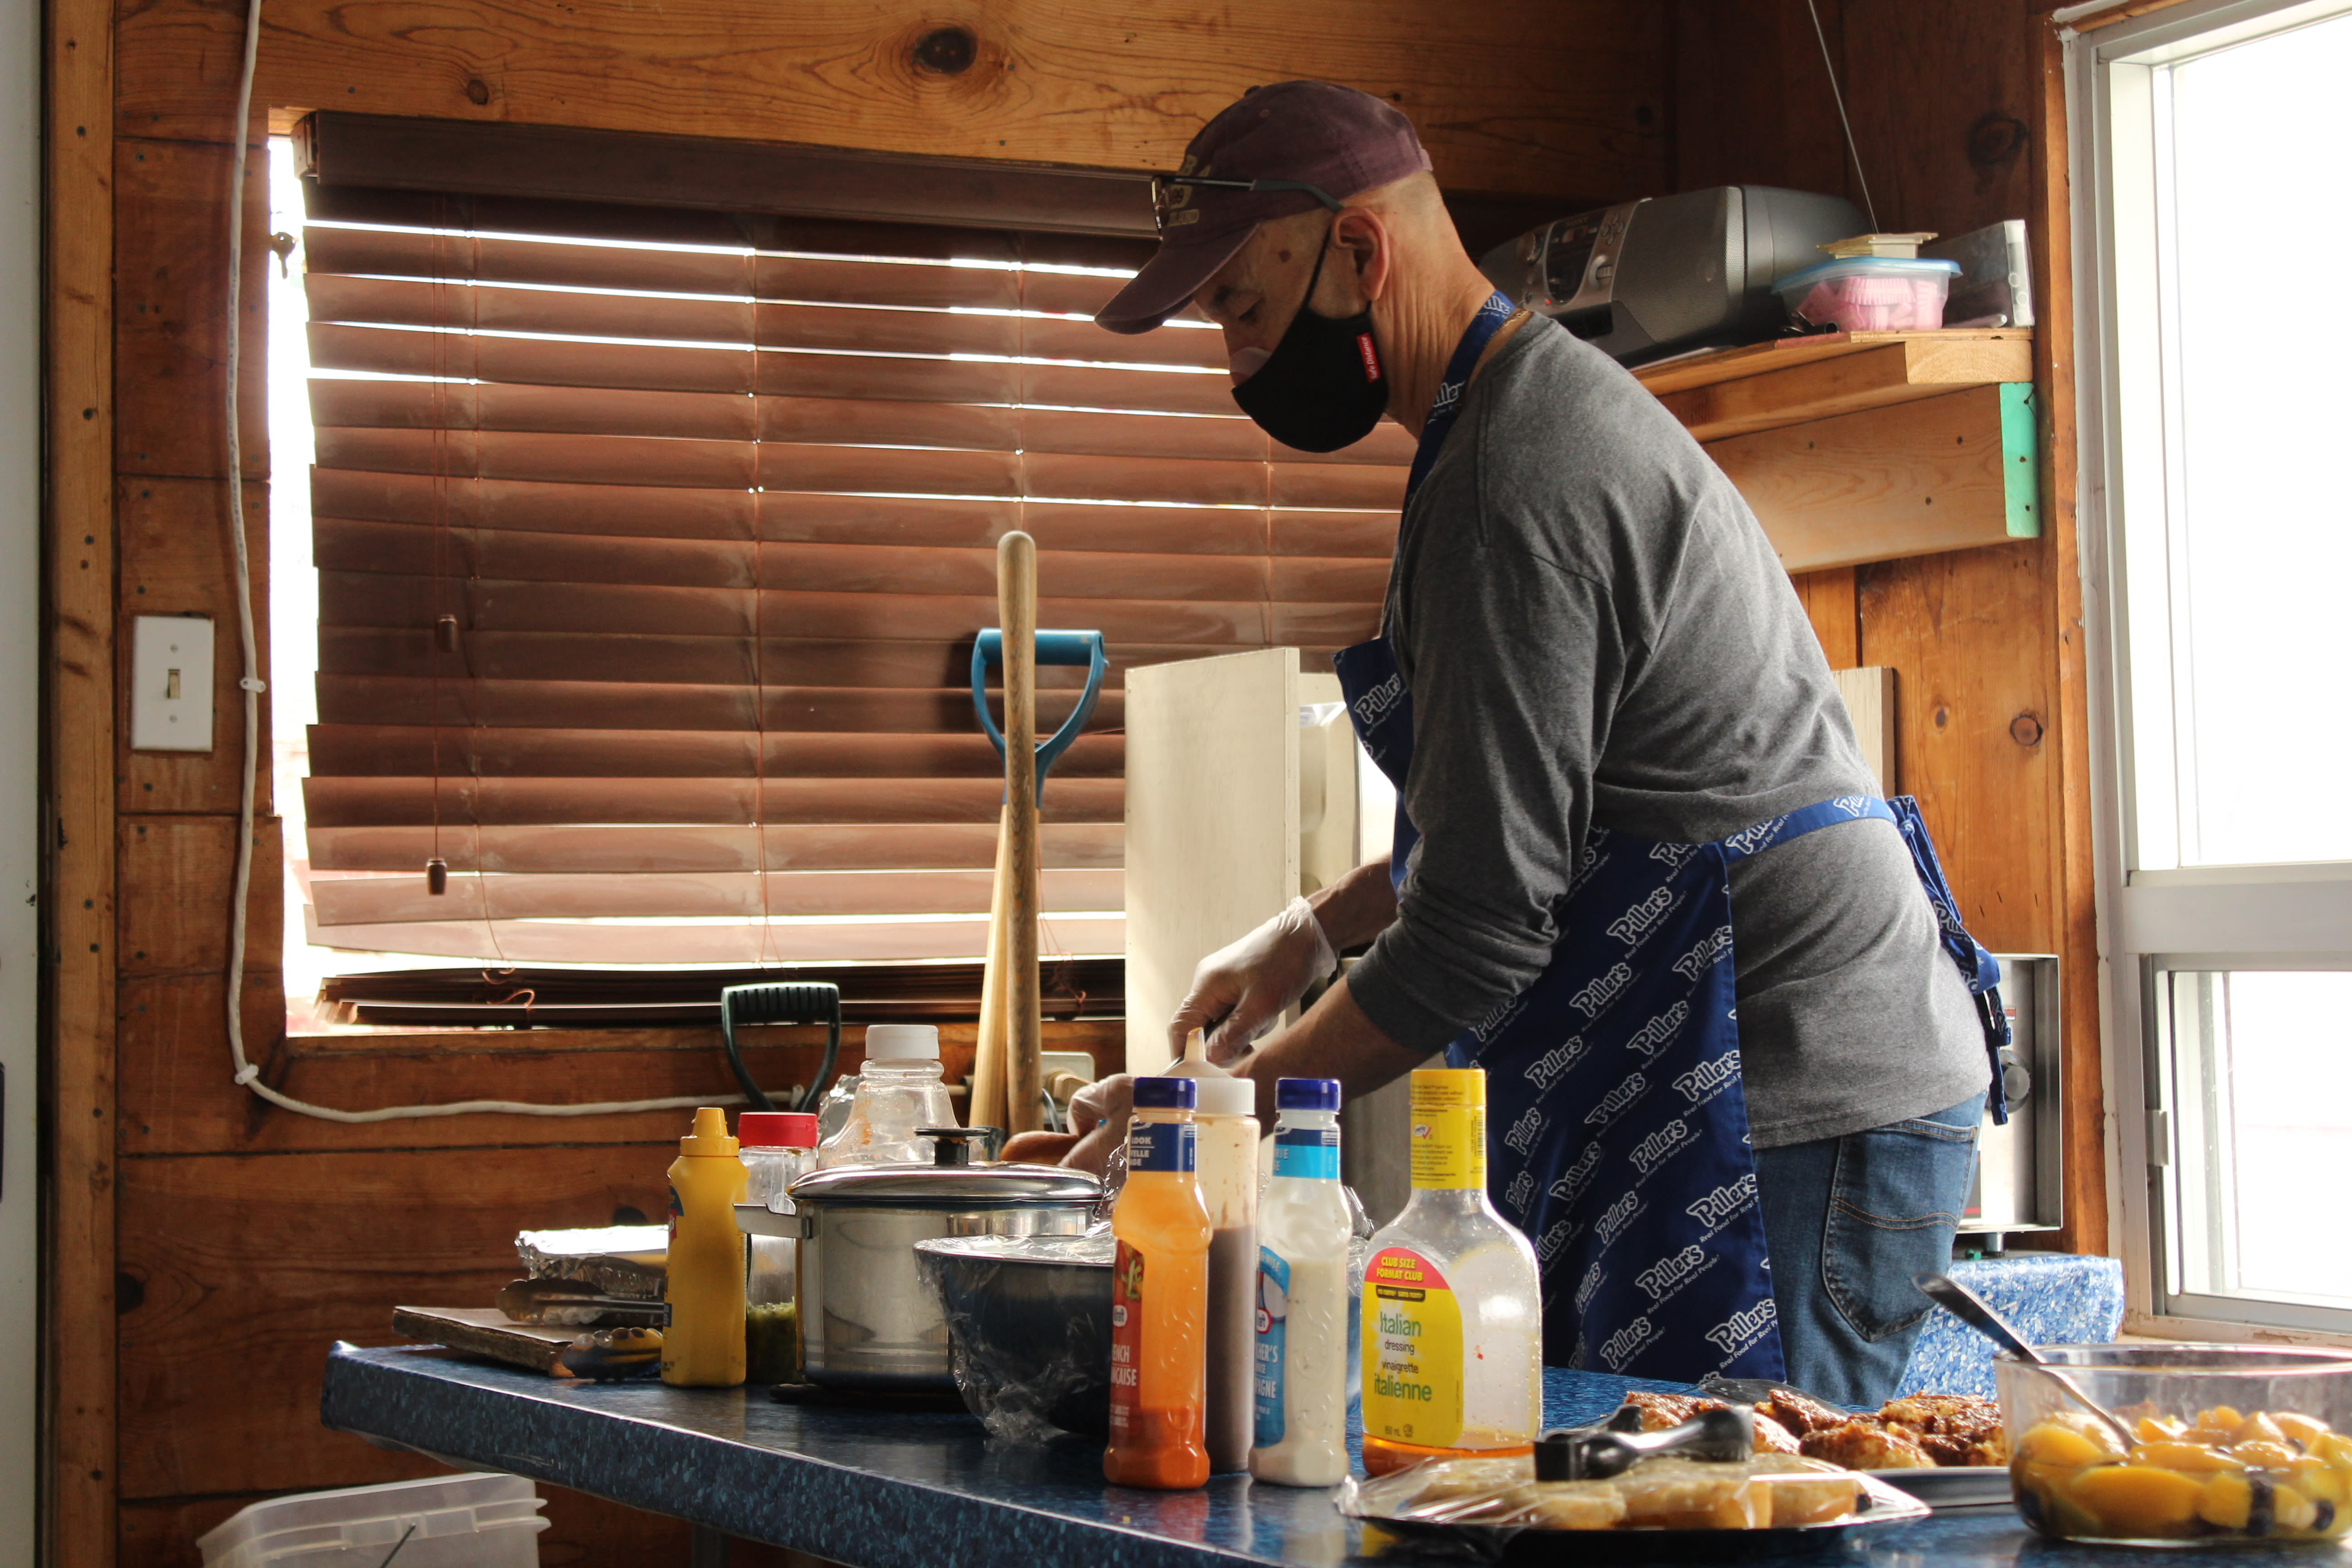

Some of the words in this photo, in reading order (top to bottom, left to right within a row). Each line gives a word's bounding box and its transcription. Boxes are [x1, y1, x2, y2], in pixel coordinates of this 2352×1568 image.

[1361, 337, 1374, 364] Distance
[1606, 886, 1672, 945] Piller's
[1624, 946, 1637, 960] Real
[1636, 934, 1650, 948] Food
[1649, 926, 1657, 935] for
[1656, 910, 1671, 926] Real
[1713, 951, 1728, 964] Real
[1569, 963, 1632, 1017] Piller's
[1626, 1000, 1688, 1055] Piller's
[1524, 1035, 1583, 1089] Piller's
[1641, 1058, 1654, 1070] Real
[1653, 1047, 1666, 1059] Food
[1672, 1050, 1741, 1102] Piller's
[1584, 1073, 1646, 1124] Piller's
[1683, 1105, 1698, 1117] Real
[1697, 1094, 1713, 1107] Food
[1713, 1087, 1723, 1096] for
[1723, 1076, 1737, 1088] Real
[1505, 1107, 1541, 1156] Piller's
[1629, 1119, 1687, 1173] Piller's
[1635, 1177, 1646, 1189] Real
[1667, 1146, 1681, 1158] Real
[1595, 1191, 1638, 1244] Piller's
[1686, 1174, 1758, 1227] Piller's
[1699, 1229, 1714, 1243] Real
[1714, 1218, 1730, 1232] Food
[1729, 1209, 1740, 1221] for
[1739, 1200, 1754, 1213] Real
[1537, 1220, 1572, 1261] iller's
[1622, 1218, 1633, 1230] Real
[1376, 1268, 1403, 1280] FORMAT
[1404, 1271, 1423, 1282] CLUB
[1381, 1256, 1398, 1268] CLUB
[1399, 1258, 1416, 1269] SIZE
[1635, 1245, 1705, 1299] Piller's
[1646, 1302, 1660, 1315] Real
[1659, 1290, 1674, 1304] Food
[1673, 1283, 1684, 1293] for
[1683, 1272, 1699, 1285] Real
[1698, 1254, 1721, 1274] People!
[1380, 1311, 1422, 1338] Italian
[1600, 1317, 1651, 1370] Piller's
[1705, 1298, 1777, 1354] Piller's
[1719, 1357, 1735, 1369] Real
[1734, 1344, 1749, 1359] Food
[1748, 1335, 1758, 1348] for
[1758, 1324, 1772, 1339] Real
[1112, 1343, 1130, 1363] ENCH
[1382, 1360, 1419, 1374] vinaigrette
[1385, 1339, 1415, 1355] dressing
[1635, 1343, 1647, 1357] Real
[1374, 1373, 1432, 1402] italienne
